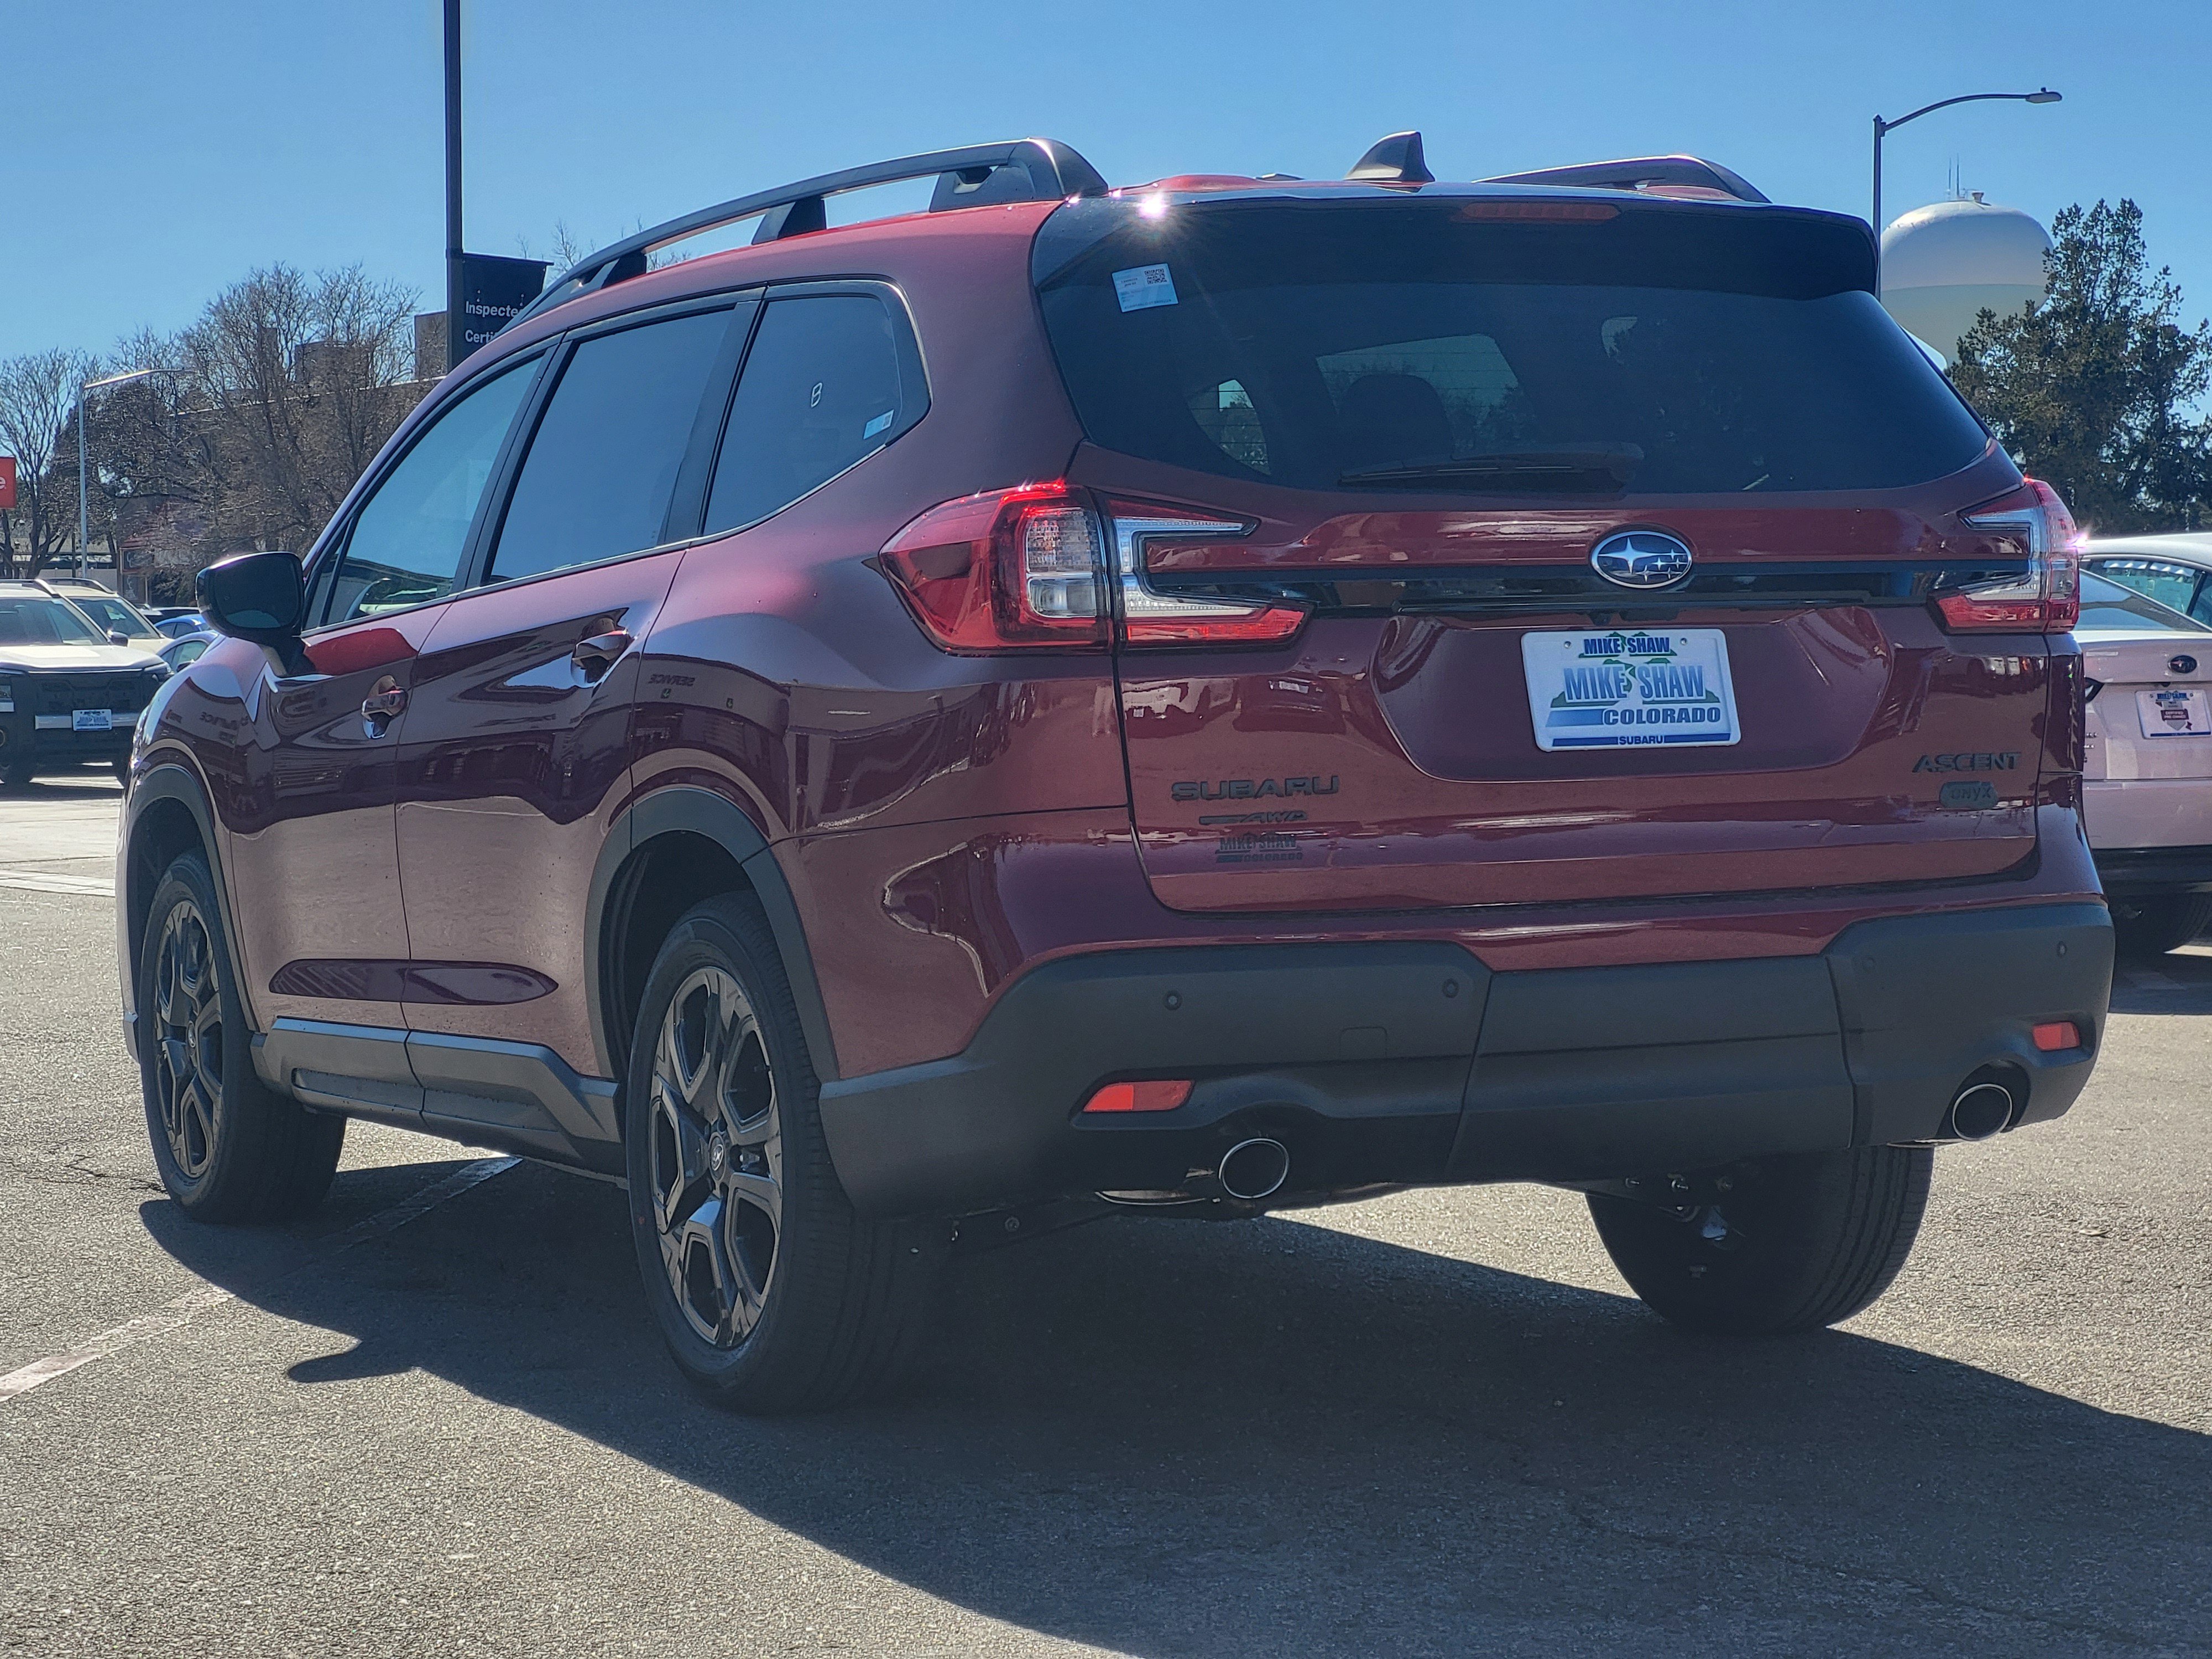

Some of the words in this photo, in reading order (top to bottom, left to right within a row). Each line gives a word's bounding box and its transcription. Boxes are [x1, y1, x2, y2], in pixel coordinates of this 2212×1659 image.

[466, 301, 523, 317] Inspecte
[465, 330, 498, 343] Certi
[1584, 638, 1621, 654] MIKE
[1628, 637, 1670, 653] SHAW
[1564, 666, 1627, 700] MIKE
[1637, 665, 1704, 699] SHAW
[1604, 707, 1720, 726] COLORADO
[1619, 735, 1665, 745] SUBARU
[1912, 752, 2021, 773] ASCENT
[1171, 775, 1340, 801] SUBARU
[1240, 810, 1308, 823] AWD
